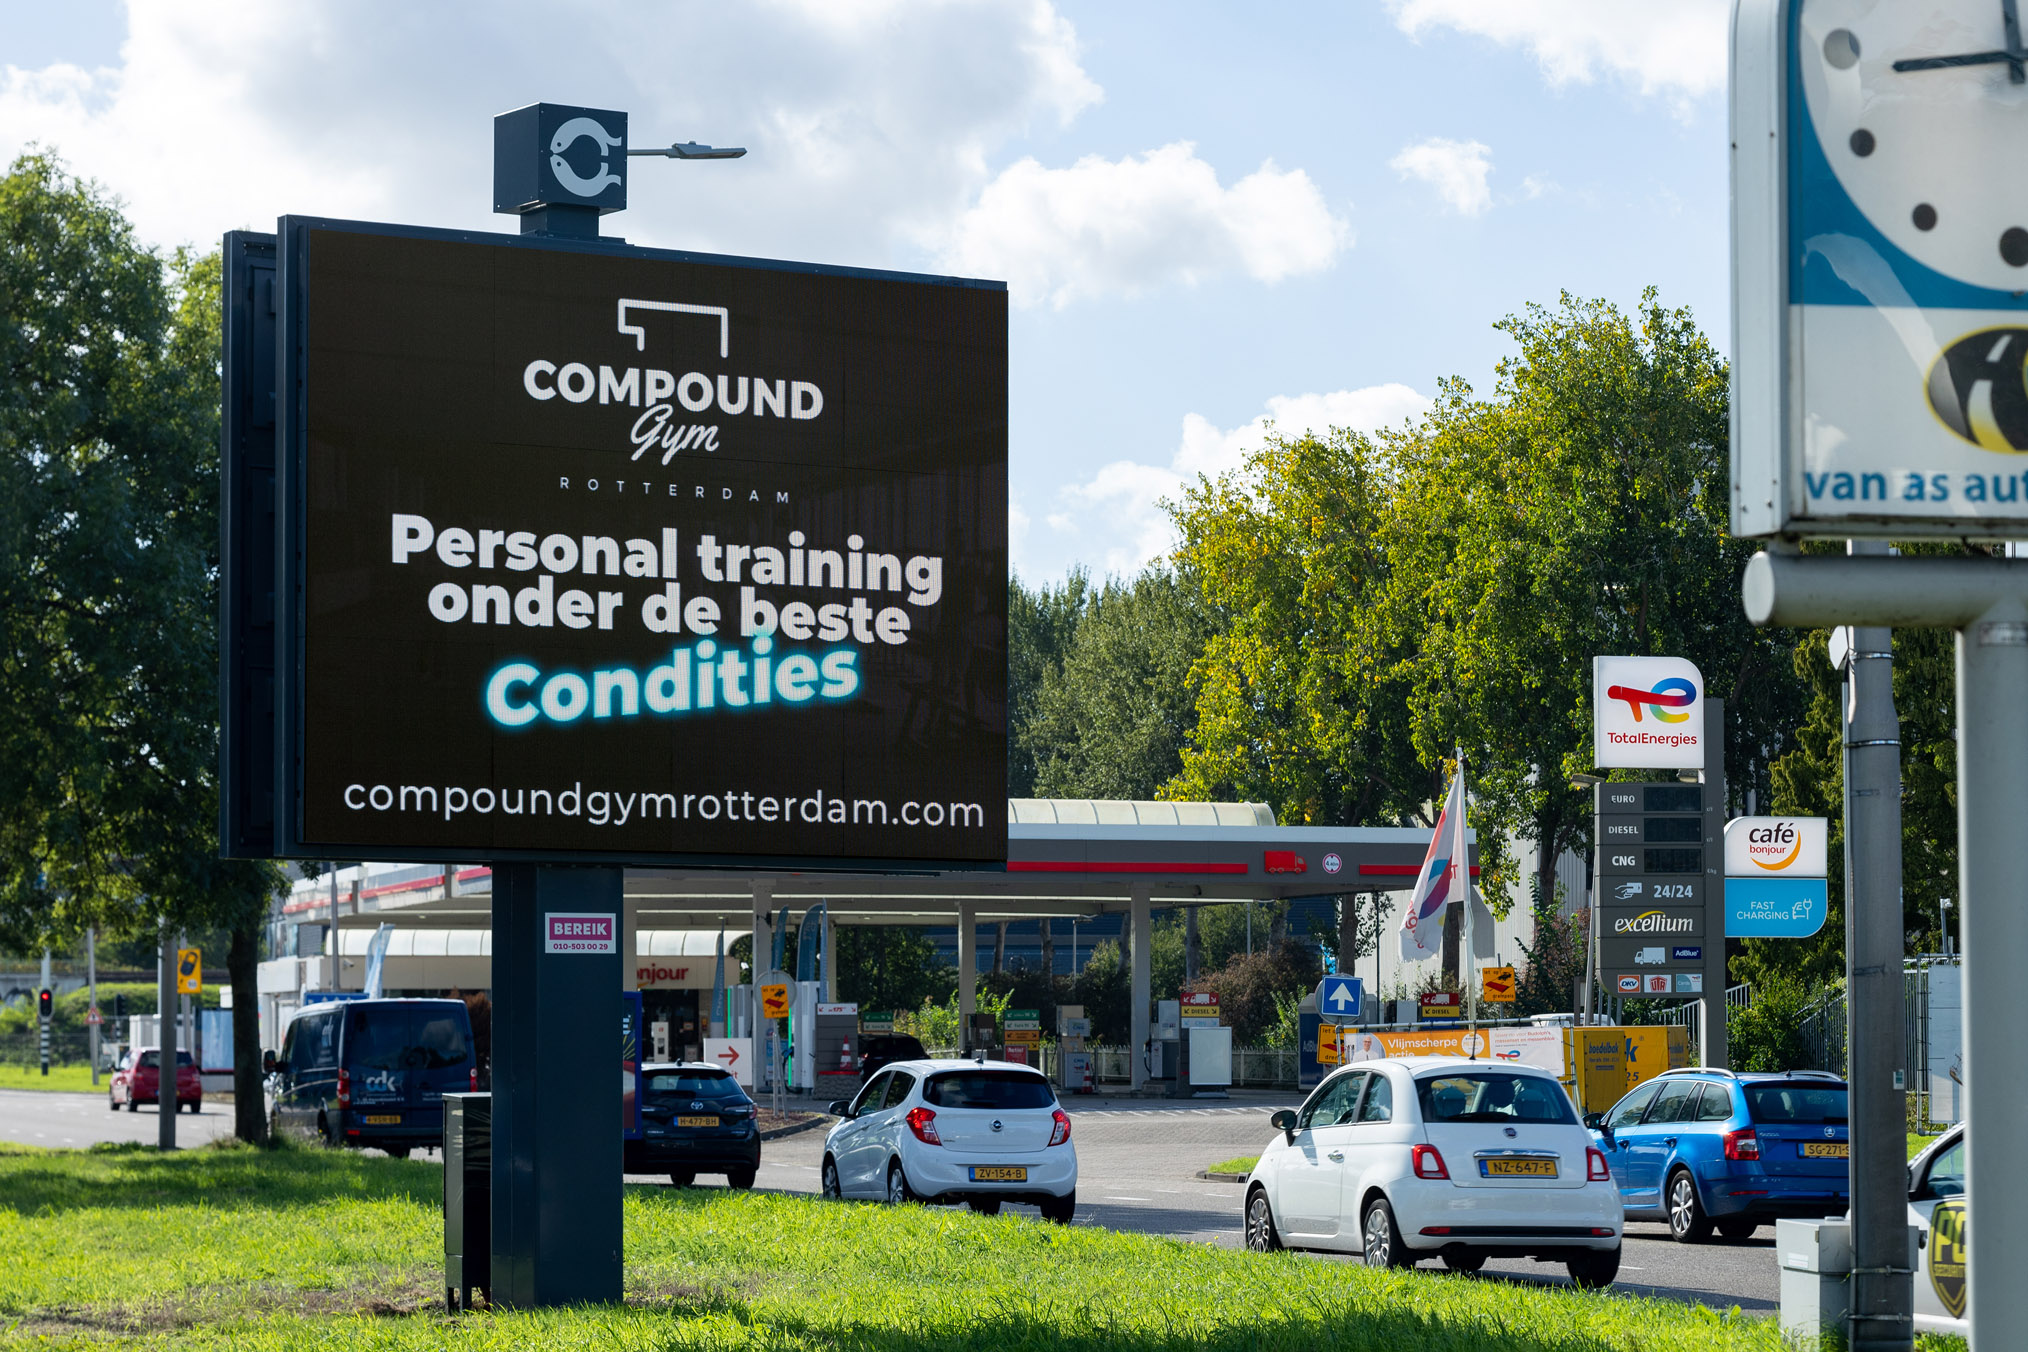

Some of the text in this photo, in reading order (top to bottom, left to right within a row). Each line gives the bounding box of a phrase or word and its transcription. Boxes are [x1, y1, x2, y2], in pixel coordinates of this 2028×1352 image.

[523, 359, 824, 420] COMPOUND
[630, 403, 719, 466] Gym
[559, 476, 789, 503] ROTTERDAM
[1805, 471, 1887, 501] van
[1903, 472, 1949, 501] as
[391, 513, 944, 606] Personal training
[428, 575, 911, 645] onder de beste
[485, 634, 860, 727] Condities
[1607, 732, 1697, 748] TotalEnergies
[343, 780, 985, 828] compoundgymrotterdam.com
[1611, 795, 1635, 803] EURO
[1608, 826, 1639, 834] DIESEL
[1749, 822, 1794, 844] café
[1749, 844, 1786, 856] bonjour
[1611, 856, 1636, 866] CNG
[1653, 884, 1693, 898] 24/24
[1750, 901, 1775, 910] FAST
[1614, 913, 1693, 932] excellium
[1736, 911, 1789, 920] CHARGING
[554, 922, 607, 936] BEREIK
[637, 963, 689, 984] njour
[1388, 1038, 1458, 1050] Vlijmscherpe
[680, 1117, 717, 1126] H-477-BH
[979, 1169, 1022, 1179] ZV-154-B
[1493, 1162, 1551, 1173] NZ-647-F
